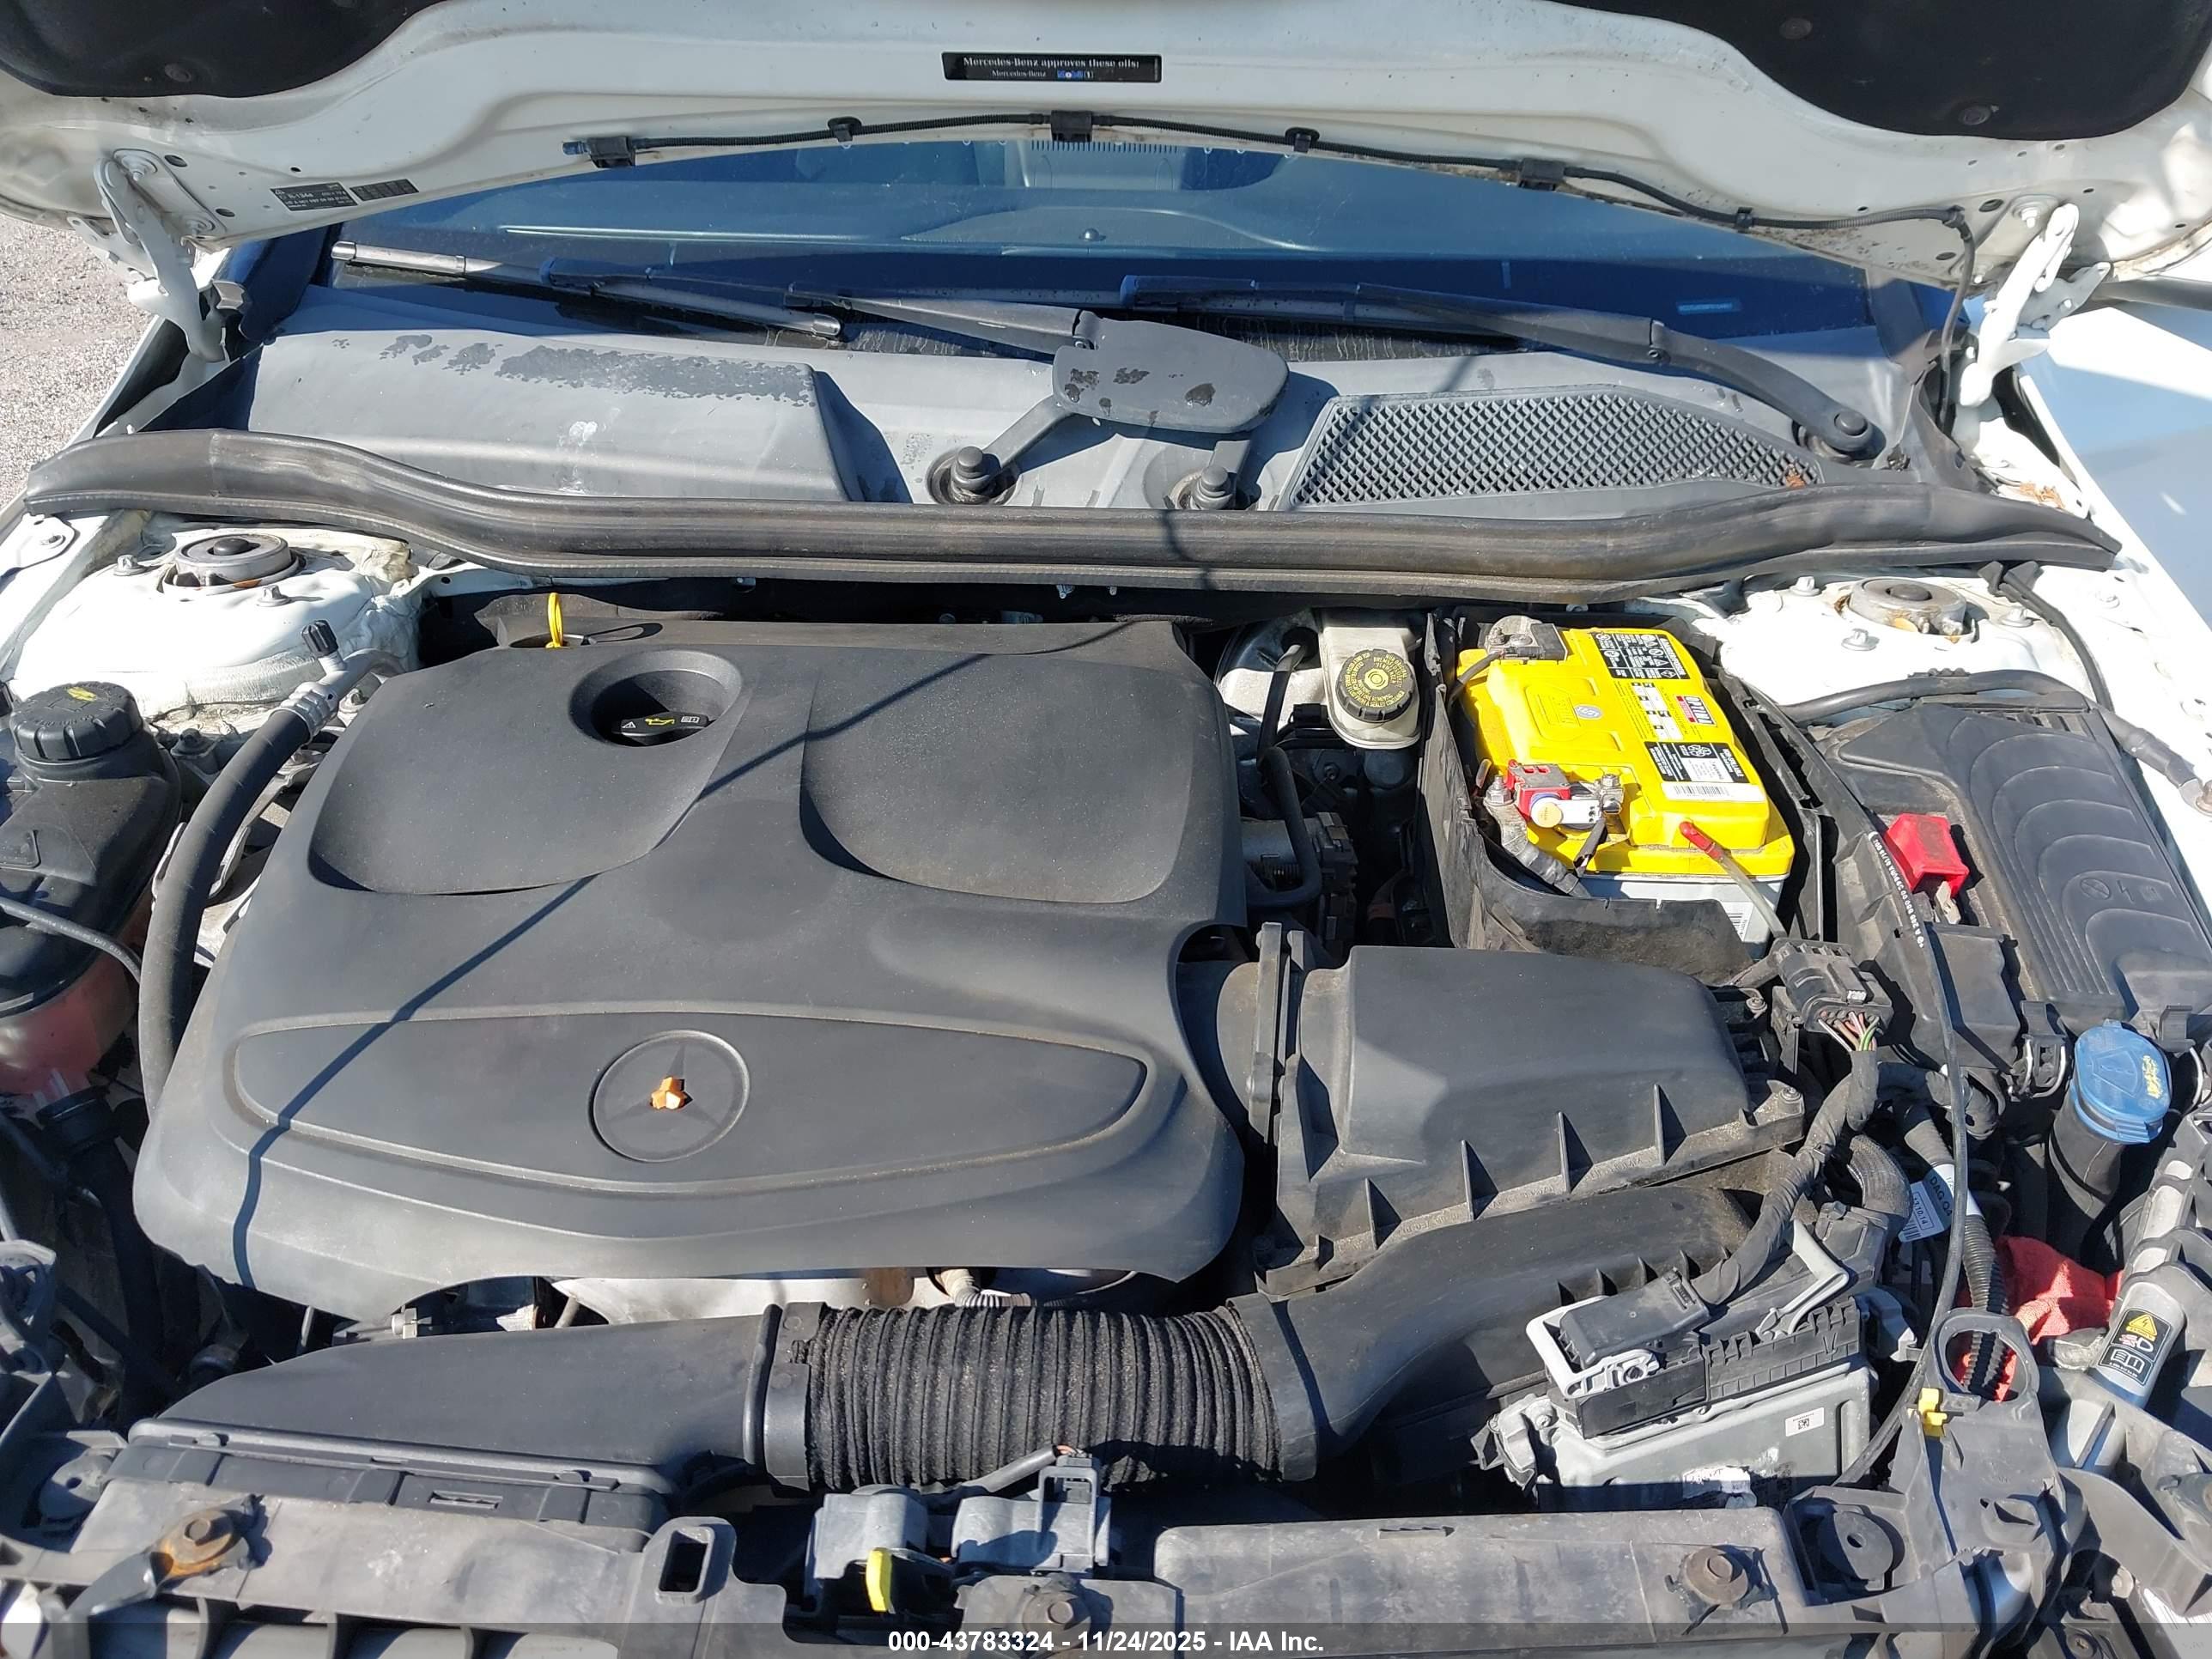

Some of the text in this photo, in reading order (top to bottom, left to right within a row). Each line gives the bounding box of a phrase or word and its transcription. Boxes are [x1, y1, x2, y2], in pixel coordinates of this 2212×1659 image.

[963, 57, 1038, 67] Mercedes-Benz
[1041, 58, 1086, 69] approves
[1089, 58, 1115, 68] these
[1684, 696, 1713, 724] OPTIMA
[1929, 1176, 1945, 1201] DAG
